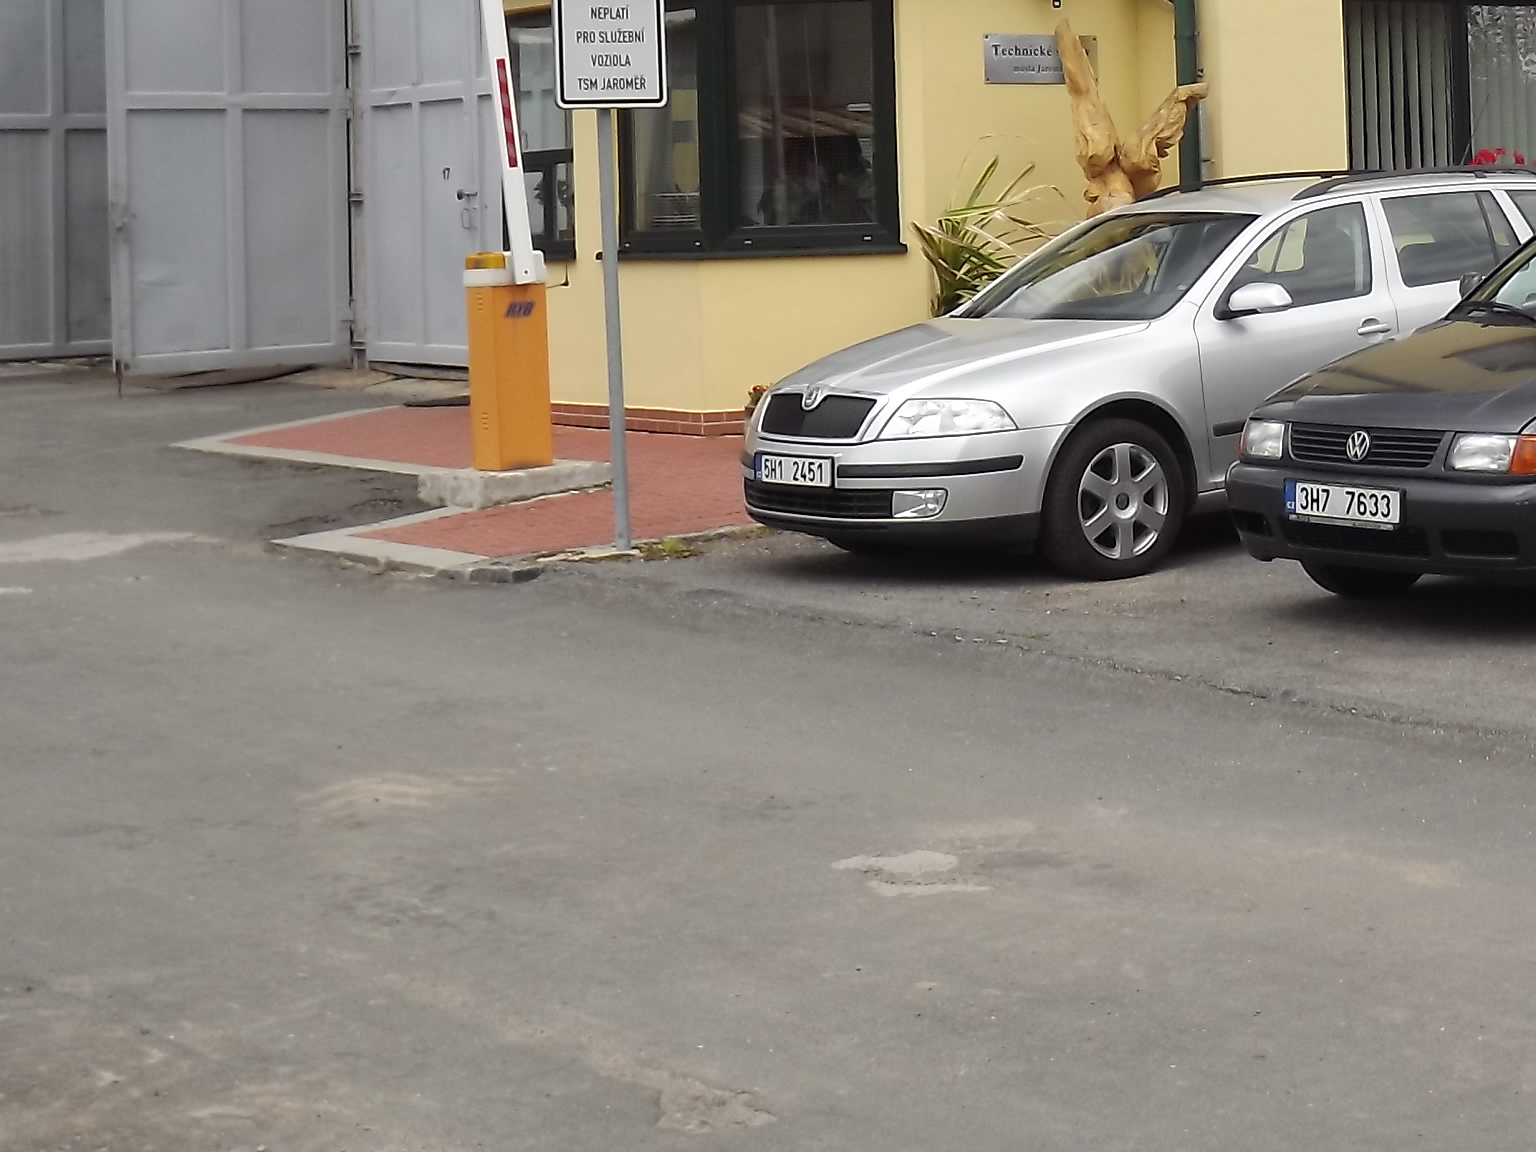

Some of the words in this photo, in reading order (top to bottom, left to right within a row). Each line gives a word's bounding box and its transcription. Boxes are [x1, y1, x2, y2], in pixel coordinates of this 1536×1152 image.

[590, 4, 630, 20] NEPLATÍ
[576, 30, 596, 43] PRO
[598, 27, 645, 44] SLUŽEBNÍ
[991, 43, 1053, 57] Technické
[590, 54, 632, 67] VOZIDLA
[577, 77, 598, 90] TSM
[600, 74, 647, 90] JAROMĚŘ
[764, 458, 783, 480] 5H1
[792, 460, 823, 484] 2451
[1300, 487, 1330, 512] 3H7
[1345, 491, 1391, 518] 7633
